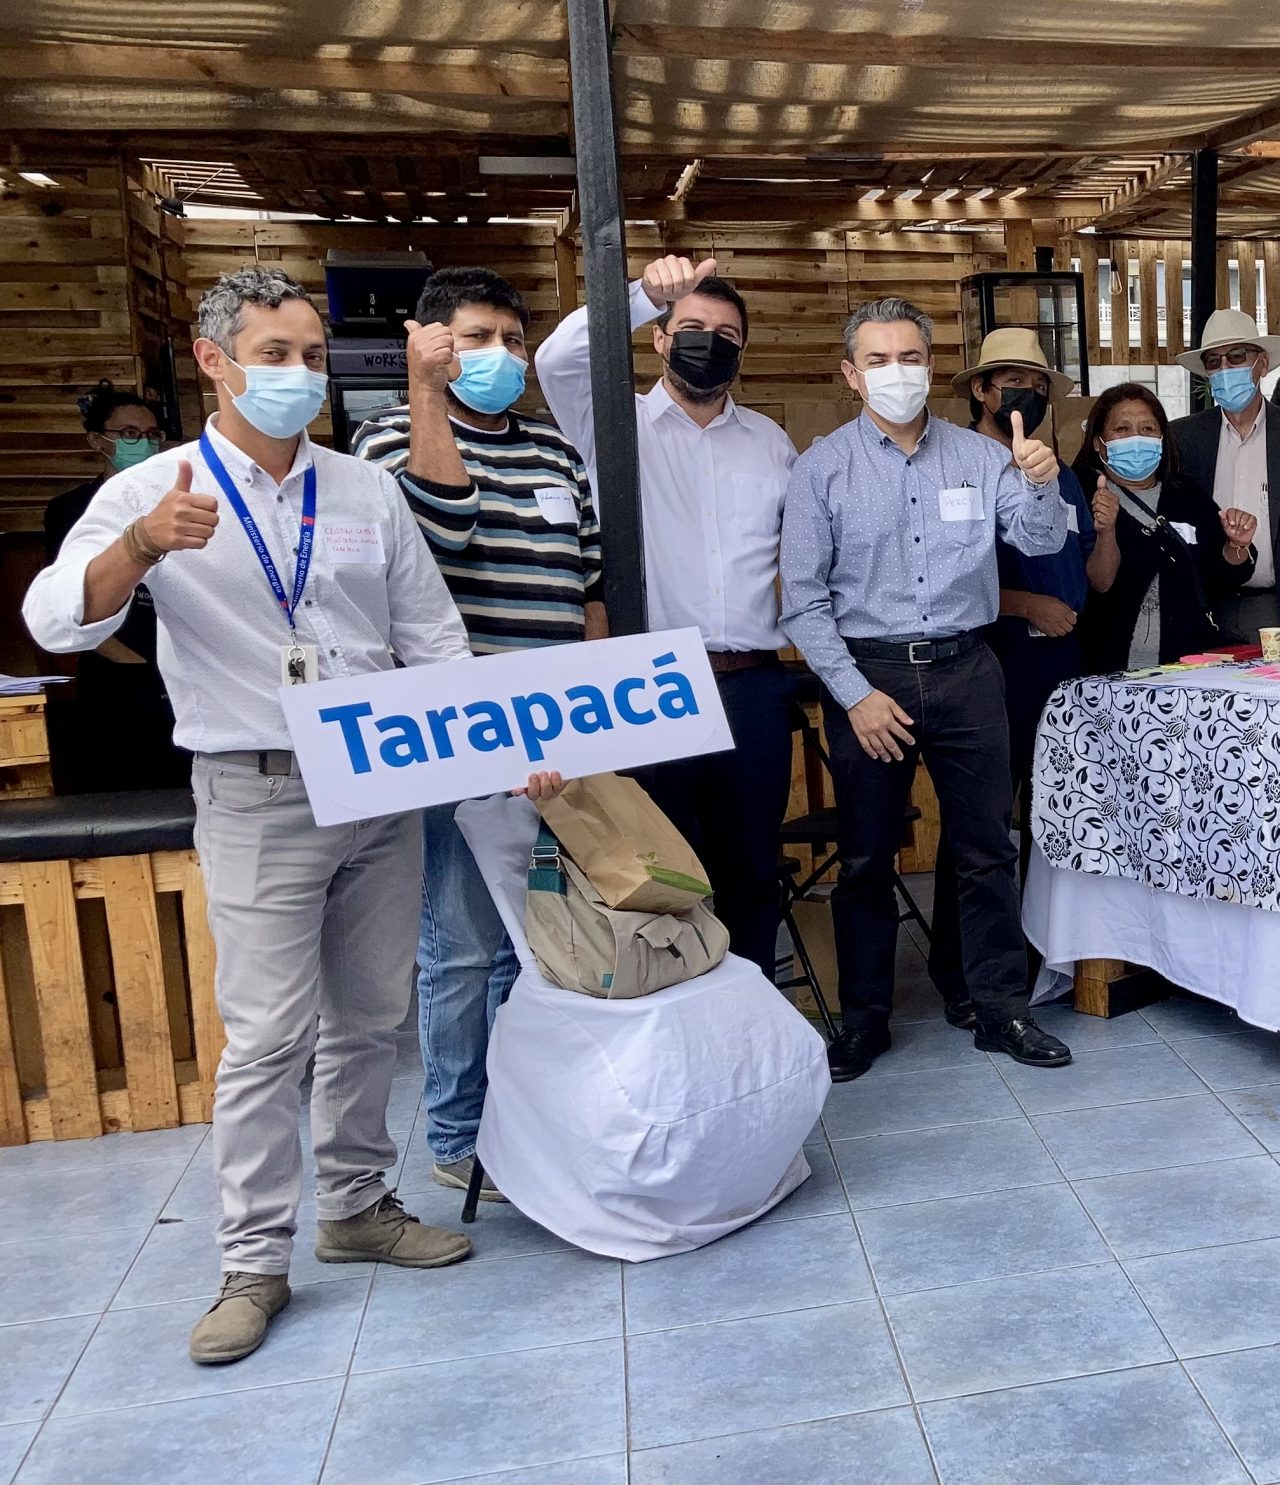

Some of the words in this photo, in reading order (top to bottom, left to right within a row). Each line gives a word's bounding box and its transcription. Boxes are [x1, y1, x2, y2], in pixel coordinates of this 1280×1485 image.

[242, 516, 264, 553] Ministerio
[261, 554, 270, 563] de
[266, 564, 282, 593] Energía
[299, 560, 307, 569] de
[300, 531, 311, 559] Energía
[318, 651, 700, 775] Tarapacá
